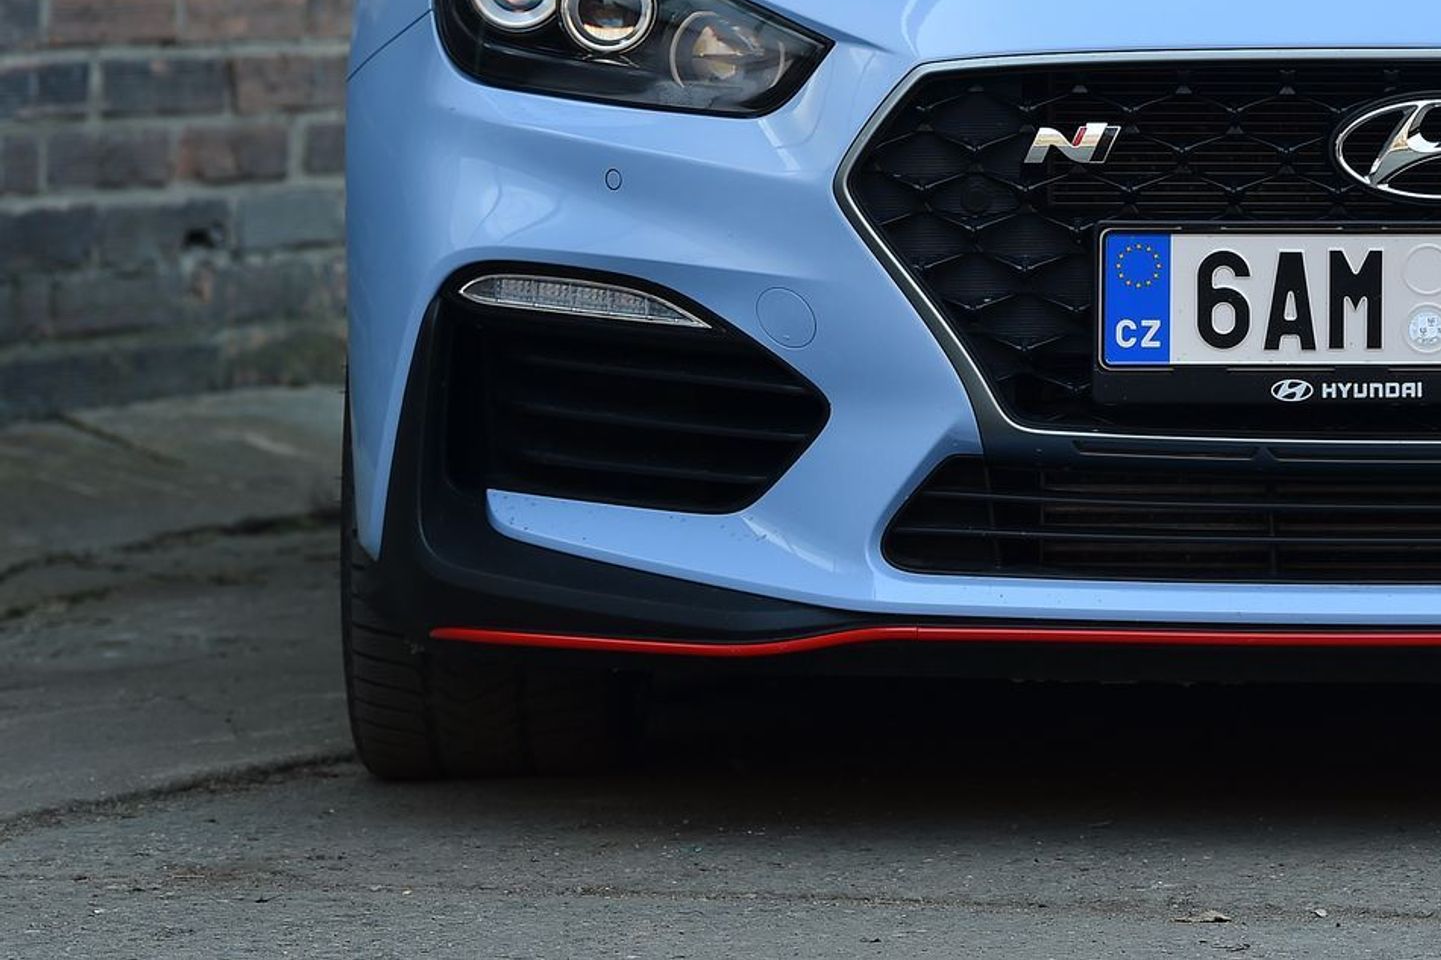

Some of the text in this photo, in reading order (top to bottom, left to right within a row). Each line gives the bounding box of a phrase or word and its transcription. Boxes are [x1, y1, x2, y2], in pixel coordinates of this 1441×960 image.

[1197, 250, 1384, 351] 6AM
[1115, 319, 1161, 348] CZ
[1321, 381, 1423, 399] HYUNDAI
